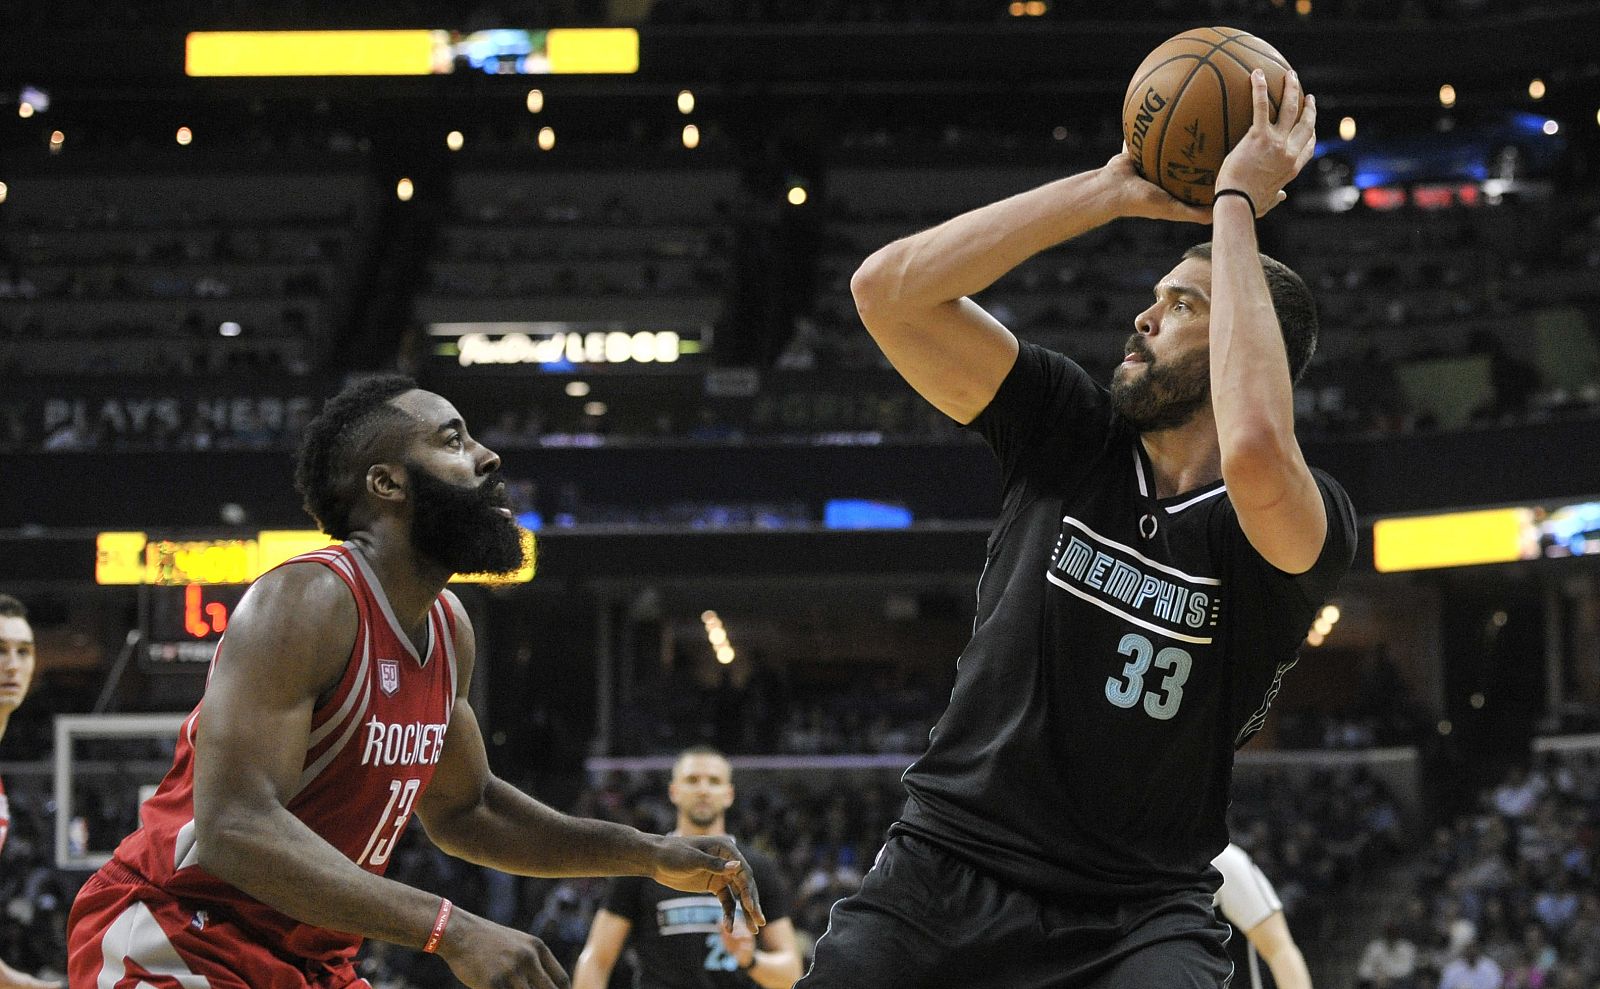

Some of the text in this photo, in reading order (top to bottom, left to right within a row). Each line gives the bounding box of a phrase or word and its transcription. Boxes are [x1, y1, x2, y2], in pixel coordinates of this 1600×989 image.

[1057, 535, 1209, 628] MEMPHIS
[383, 665, 396, 681] 50
[1105, 633, 1193, 720] 33
[361, 714, 448, 767] ROCKETS
[356, 779, 420, 866] 13
